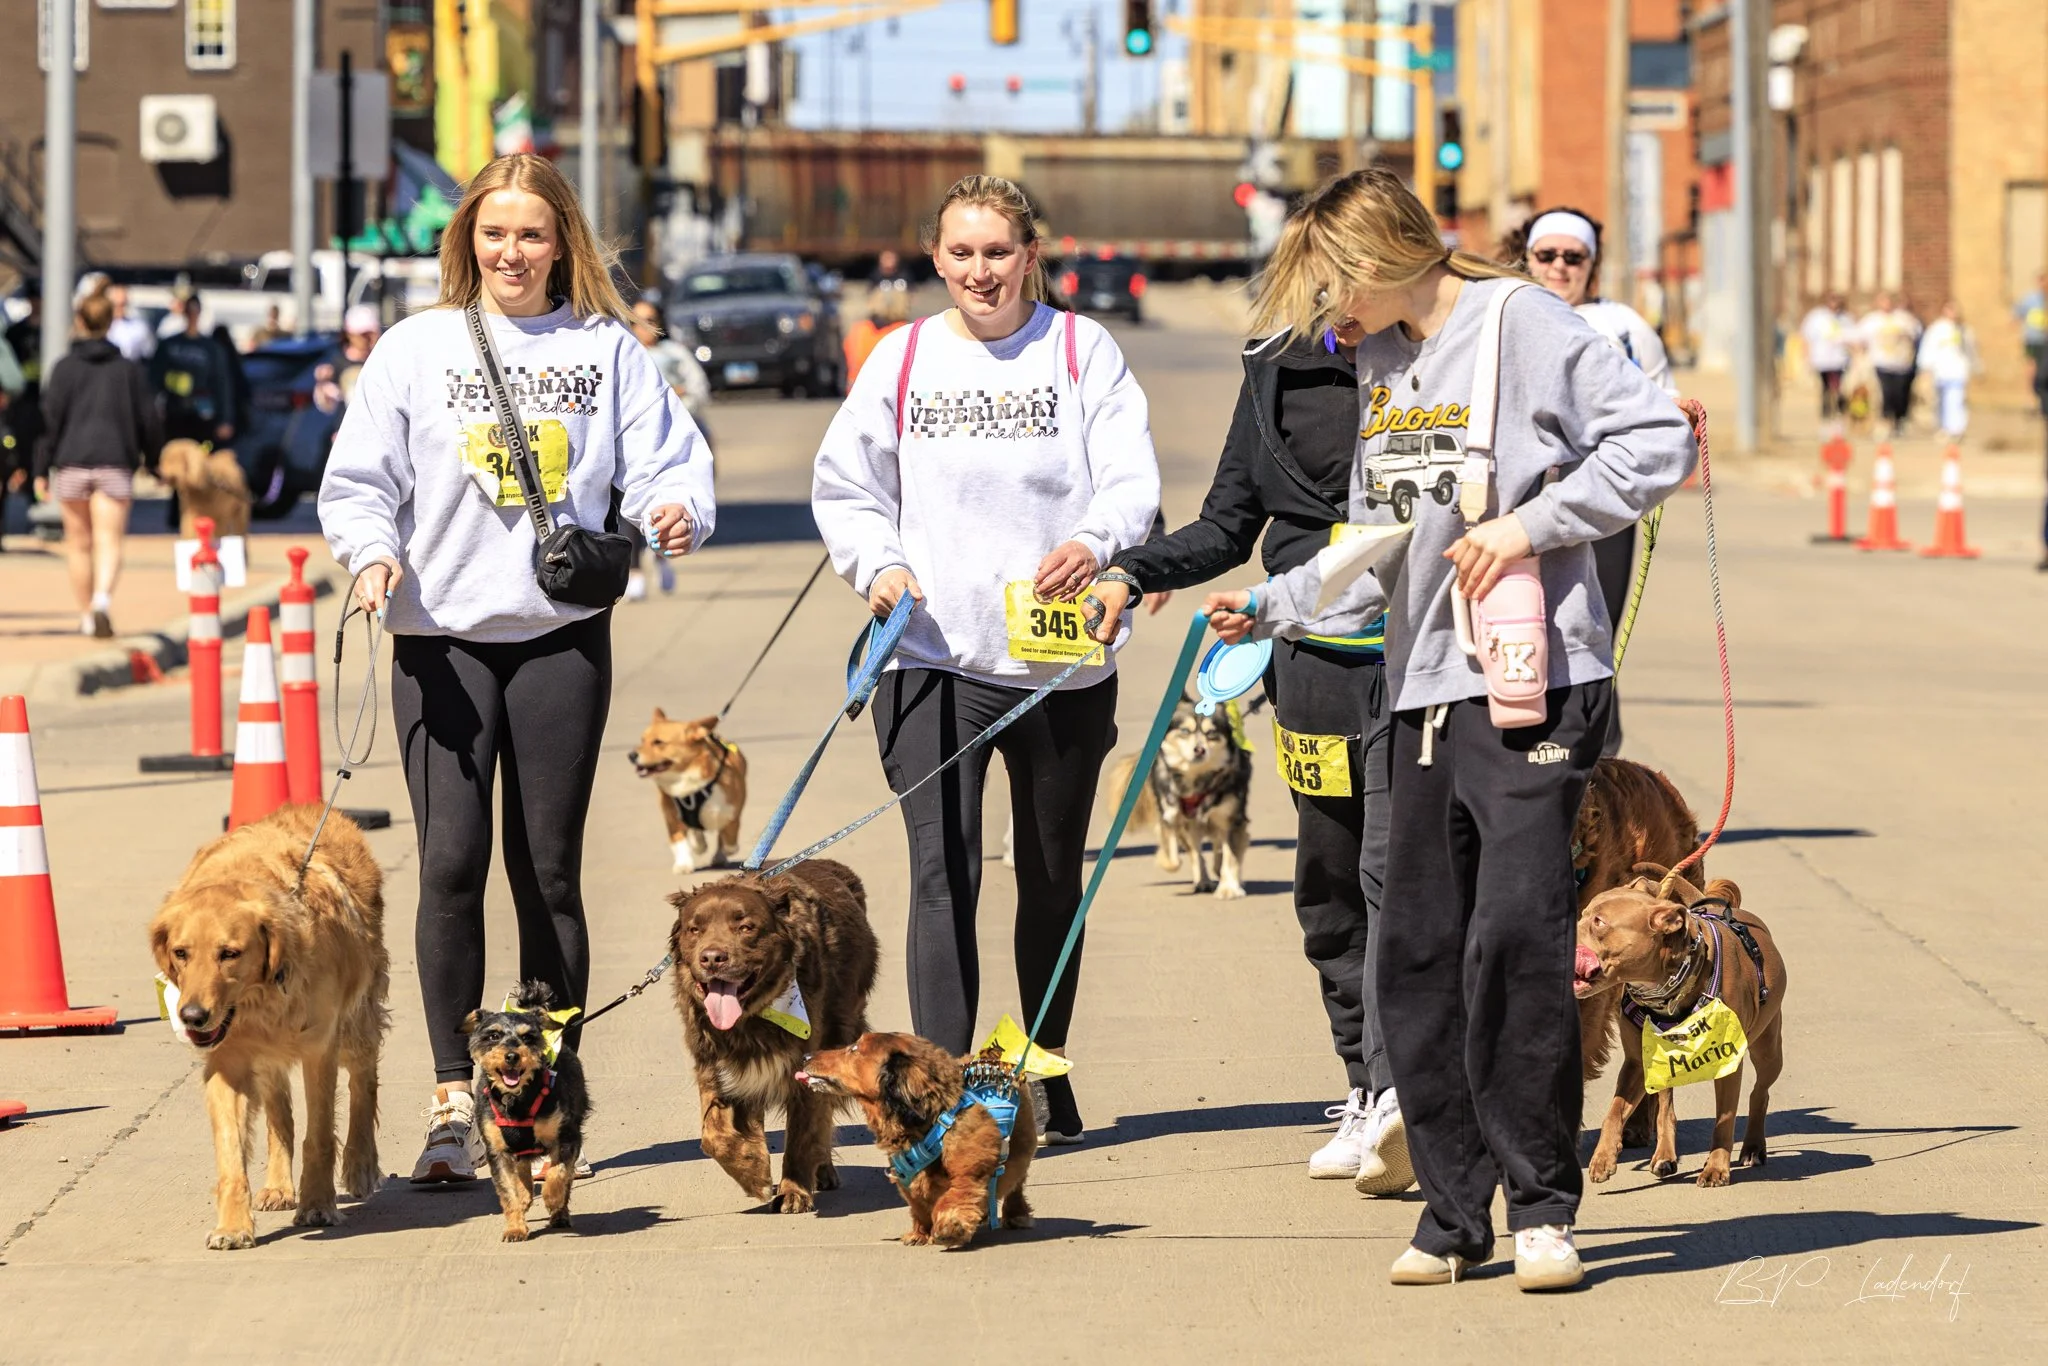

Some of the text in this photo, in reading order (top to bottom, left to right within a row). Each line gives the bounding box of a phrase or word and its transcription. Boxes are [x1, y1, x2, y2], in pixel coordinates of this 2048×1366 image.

[467, 302, 489, 353] ulemon
[446, 377, 602, 400] VETRINARY
[527, 395, 599, 417] medicine
[910, 400, 1058, 425] VETERINARY
[495, 383, 525, 460] lululemon
[985, 421, 1059, 442] medicine
[527, 492, 550, 540] lulule
[1030, 608, 1078, 640] 345
[1503, 642, 1538, 682] K
[1299, 738, 1319, 755] 5K
[1527, 750, 1547, 763] OLD
[1546, 748, 1570, 761] NAVY
[1283, 753, 1322, 790] 343
[1687, 1016, 1712, 1038] 5K
[1668, 1041, 1739, 1078] Maria
